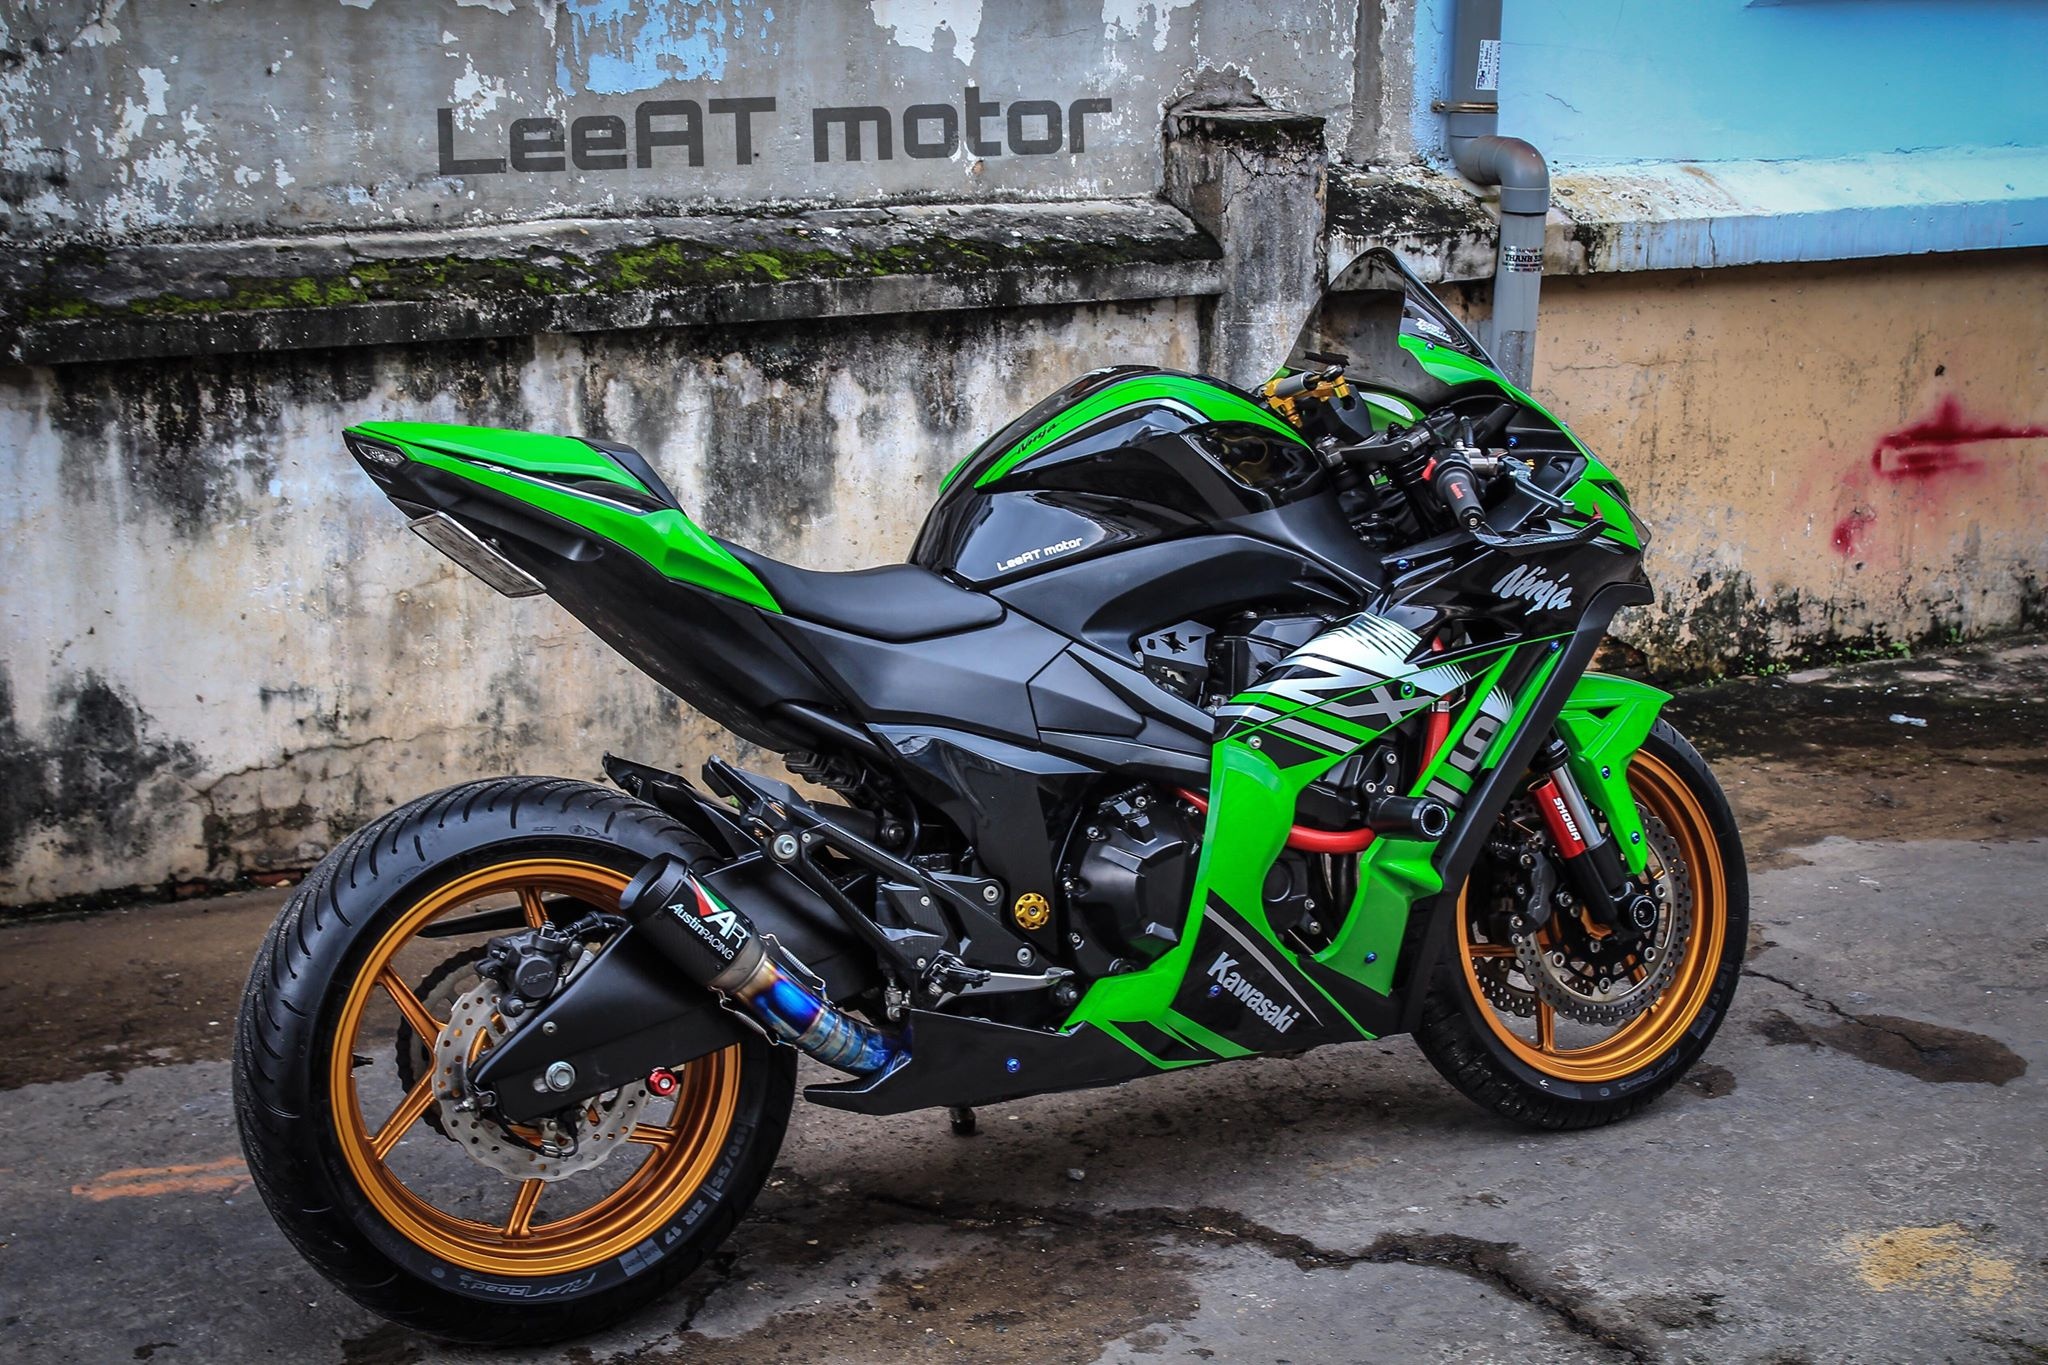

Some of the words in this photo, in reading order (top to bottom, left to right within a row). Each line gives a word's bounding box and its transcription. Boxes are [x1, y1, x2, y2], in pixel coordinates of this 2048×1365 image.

[1043, 537, 1083, 556] motor
[1491, 564, 1573, 616] Ninja
[1552, 797, 1581, 841] SHOWA
[1207, 951, 1301, 1034] Kawasaki
[664, 1226, 682, 1245] 17
